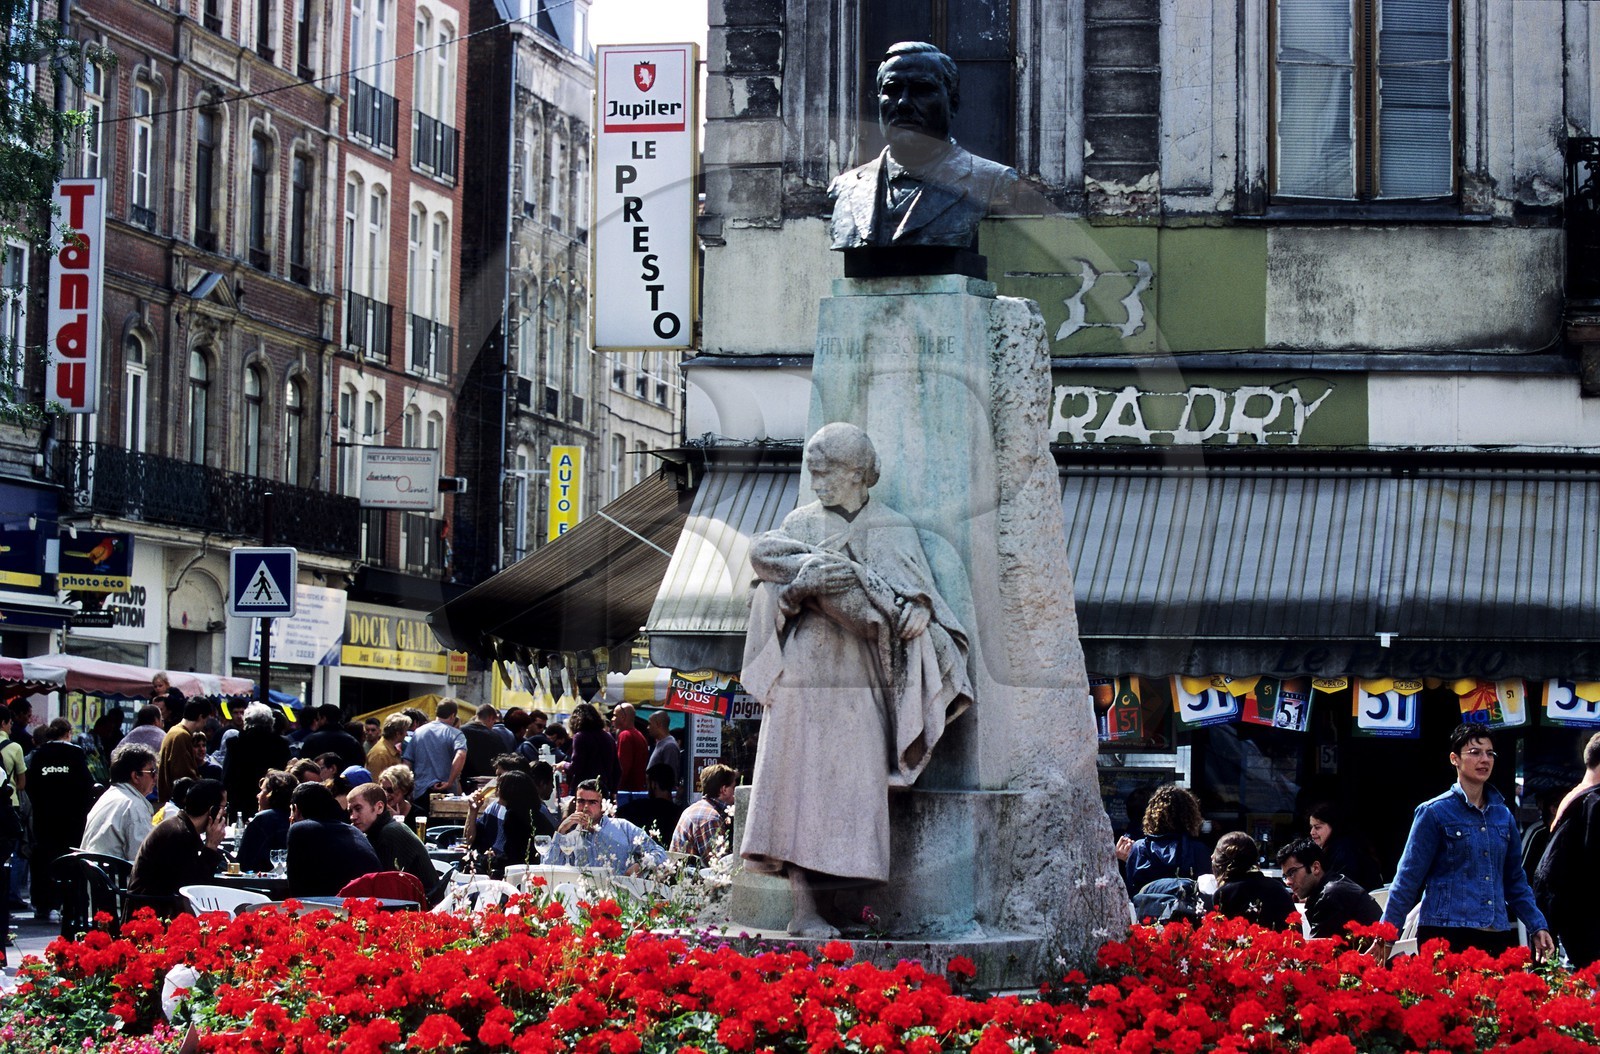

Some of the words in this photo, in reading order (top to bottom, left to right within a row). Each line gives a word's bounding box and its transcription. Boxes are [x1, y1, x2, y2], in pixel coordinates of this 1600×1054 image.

[607, 99, 682, 121] Jupiler
[631, 140, 657, 160] LE
[615, 164, 681, 340] PRESTO
[56, 184, 95, 408] Tandy
[558, 454, 572, 512] AUTO
[349, 613, 391, 648] DOCK
[1274, 646, 1329, 673] Le
[671, 678, 719, 696] rendez
[732, 698, 764, 718] pign
[1120, 711, 1138, 731] 51
[1278, 701, 1301, 730] 51
